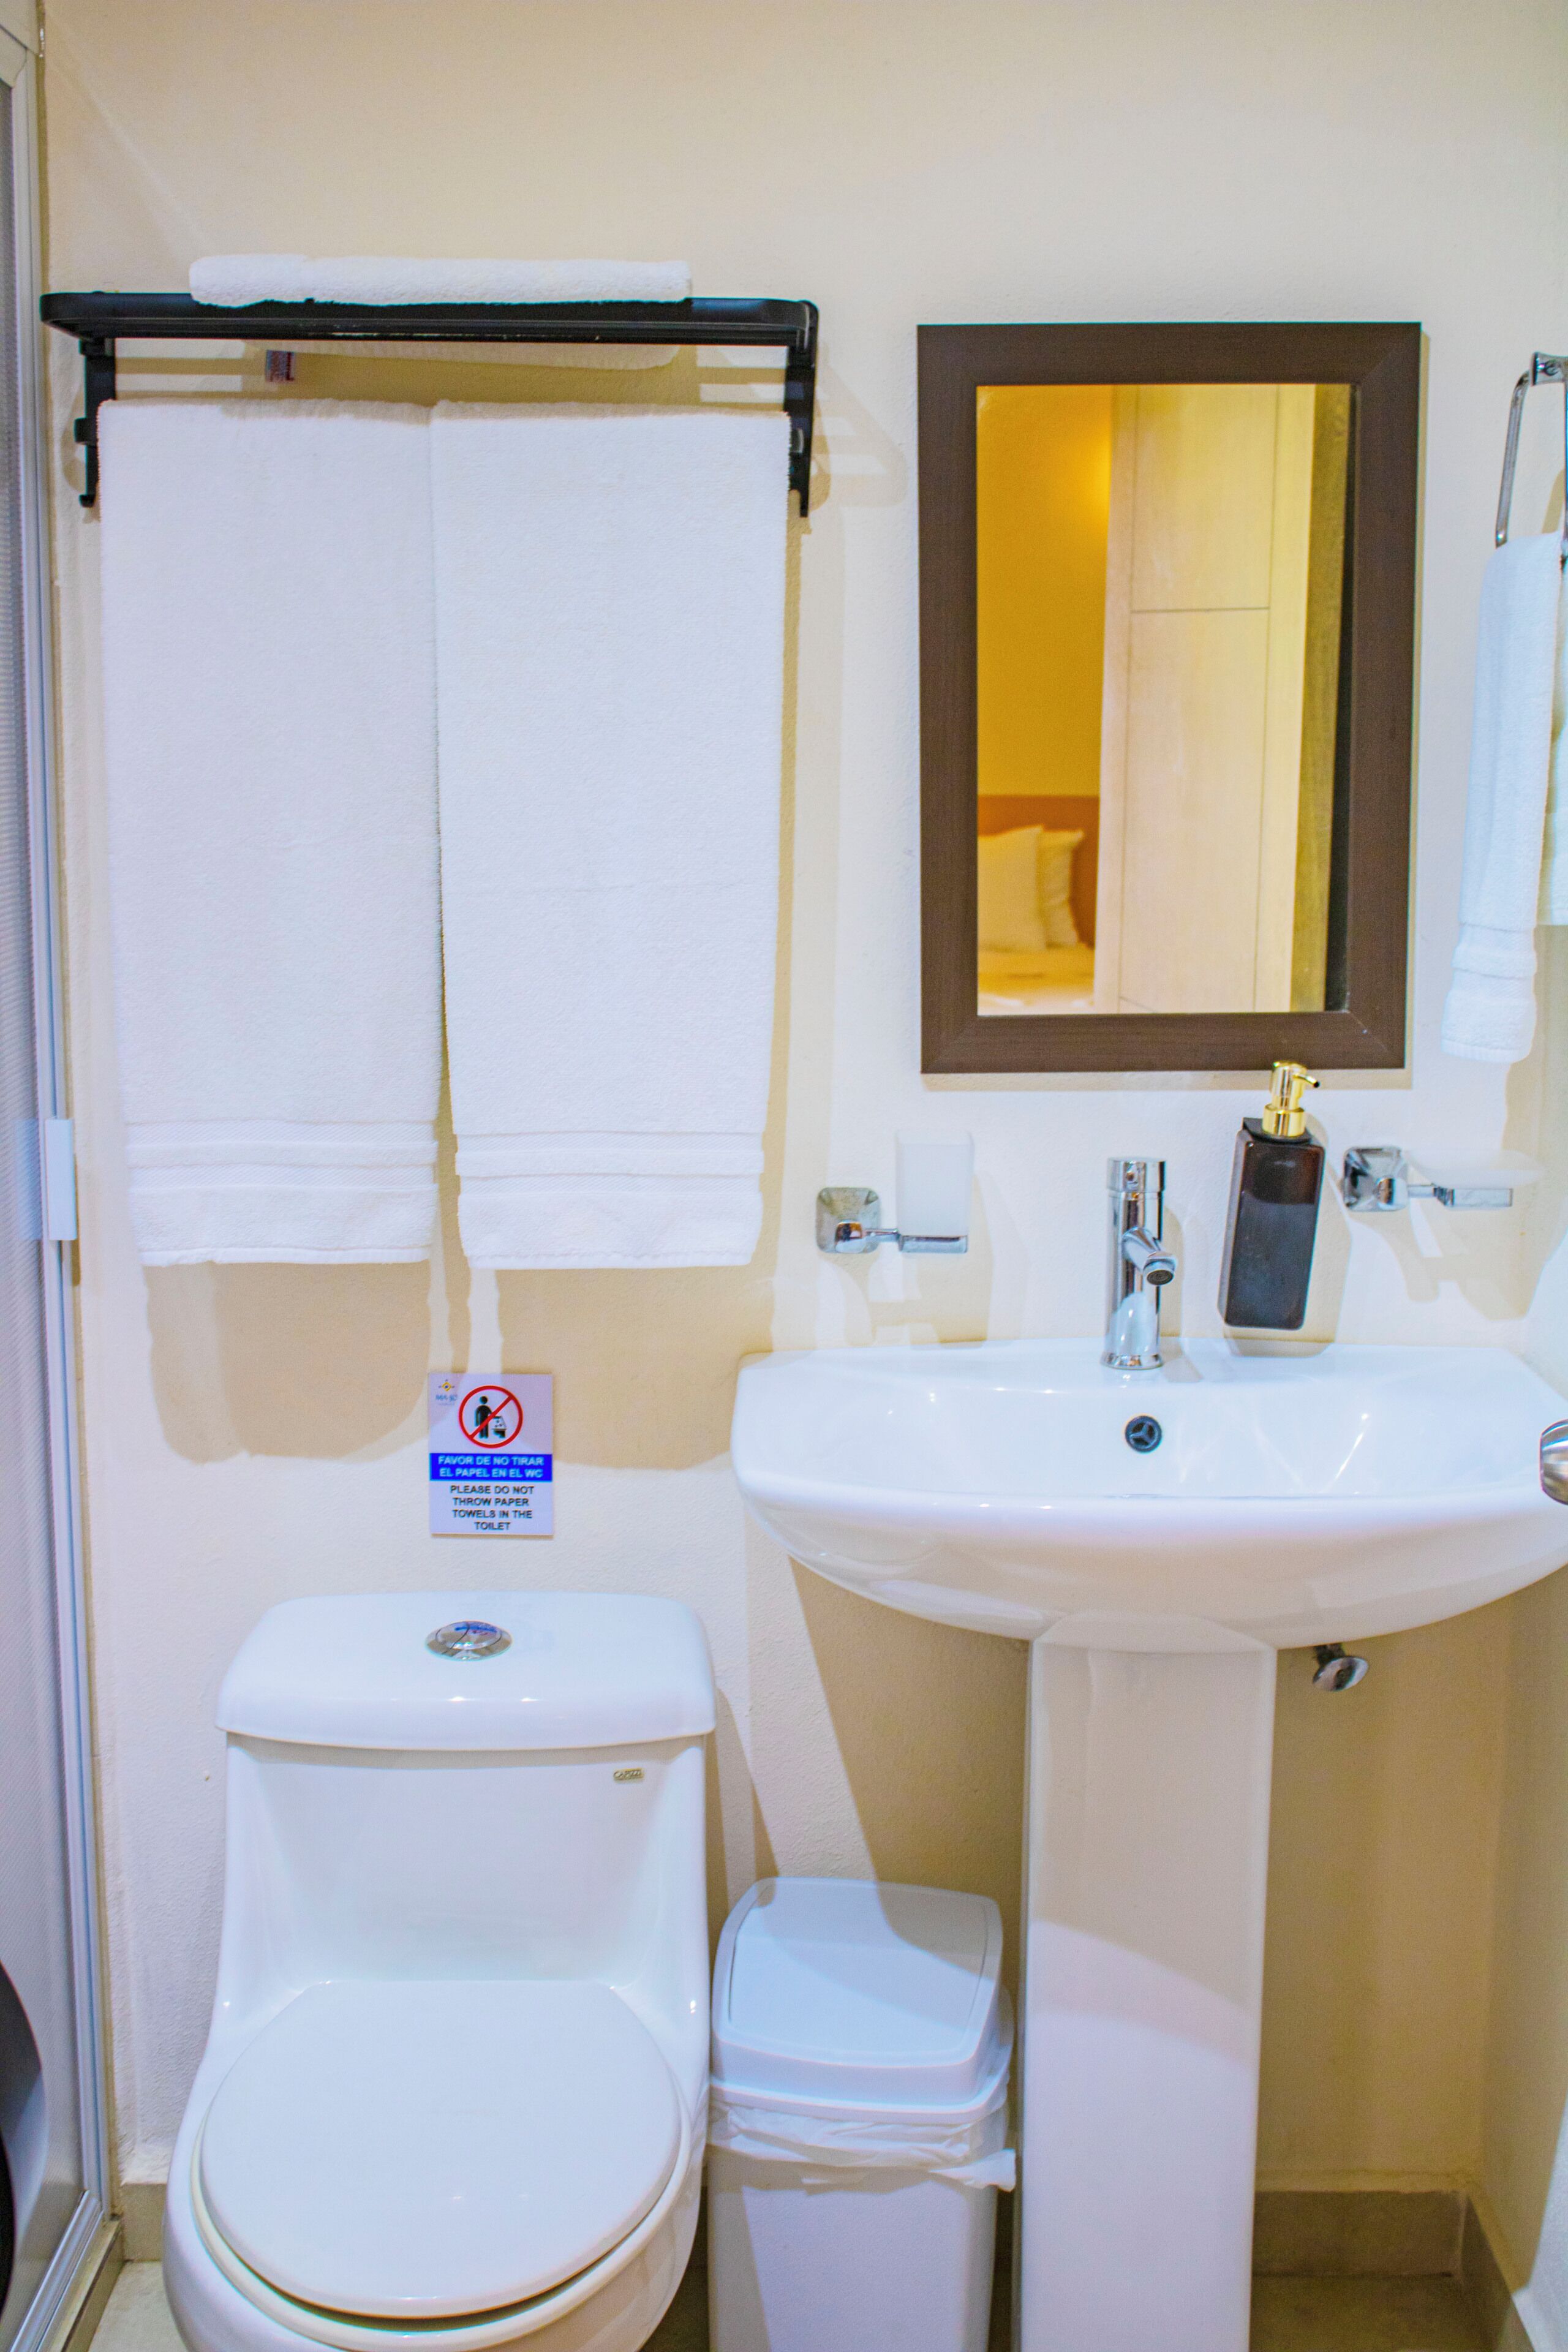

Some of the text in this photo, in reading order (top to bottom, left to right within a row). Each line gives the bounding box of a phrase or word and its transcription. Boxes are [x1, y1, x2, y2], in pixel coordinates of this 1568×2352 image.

[439, 1455, 544, 1466] FAVOR DE NO TIRAR
[439, 1468, 543, 1478] EL PAPEL EN EL WC
[450, 1485, 491, 1494] PLEASE
[513, 1486, 534, 1494] NOT
[453, 1498, 492, 1506] THROW
[453, 1509, 496, 1518] TOWELS
[475, 1521, 511, 1530] TOILET
